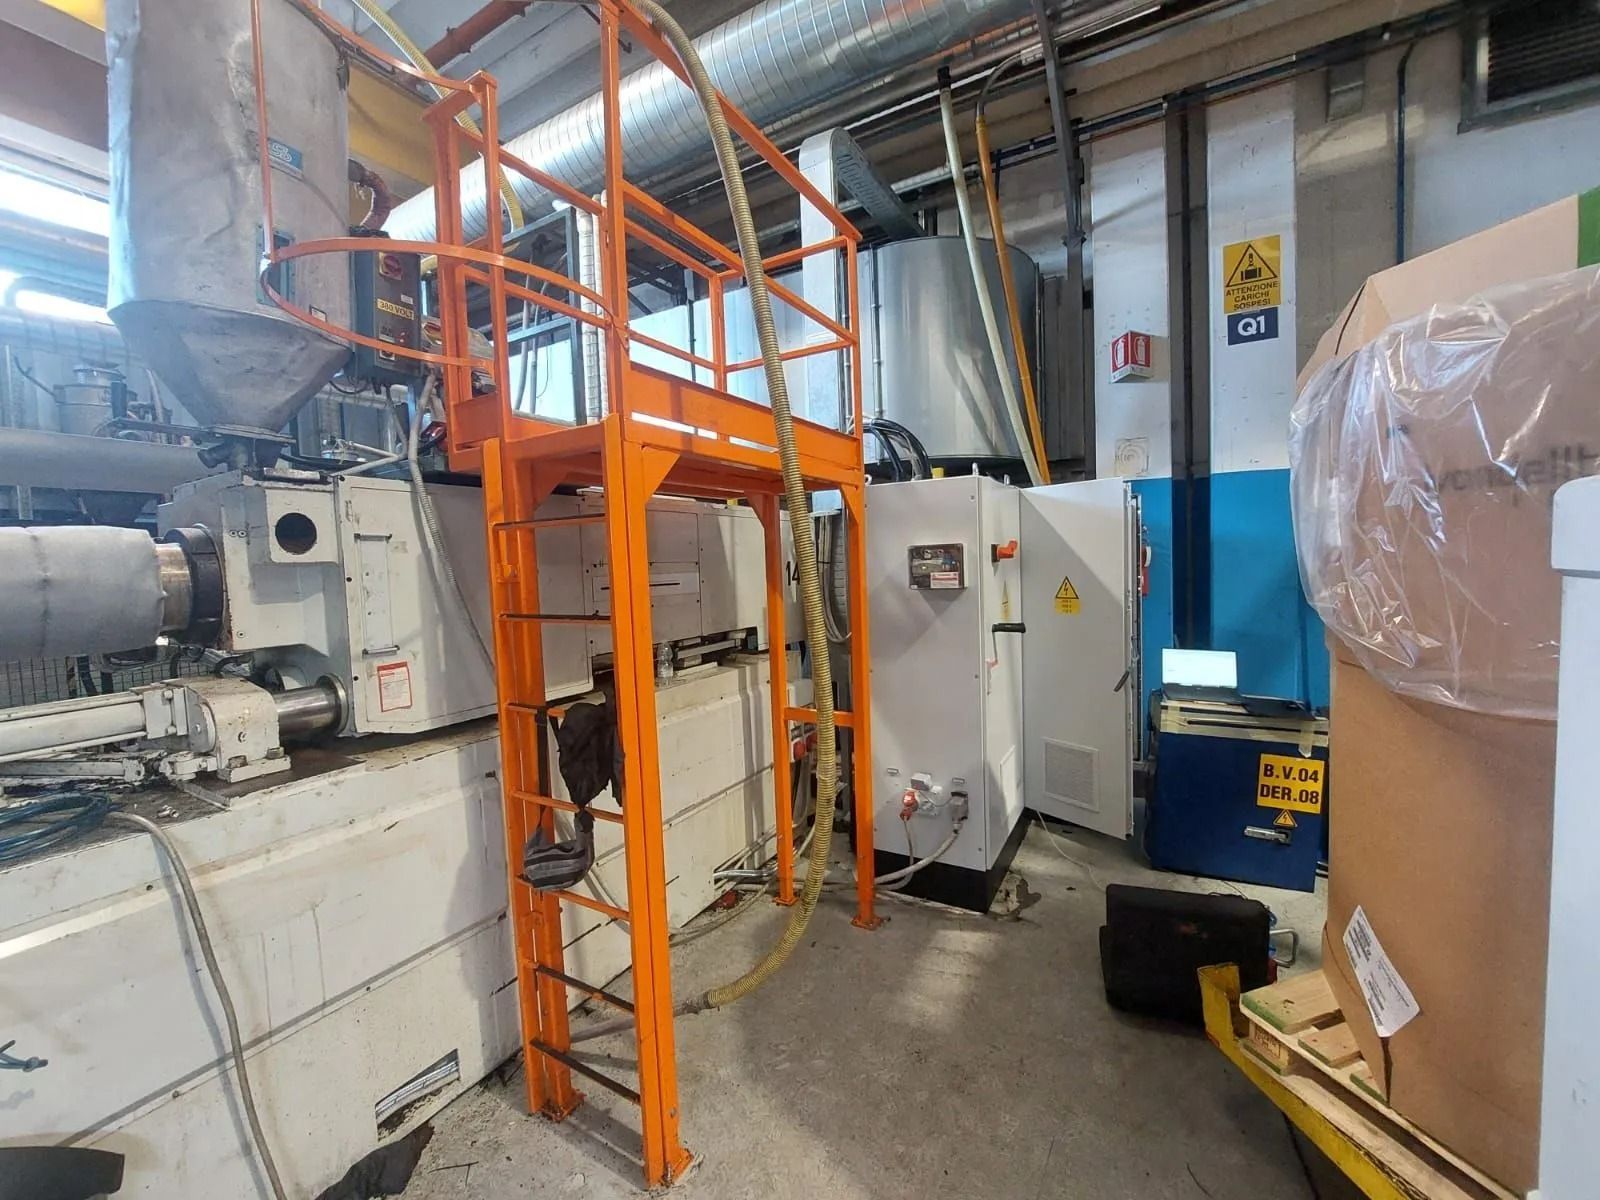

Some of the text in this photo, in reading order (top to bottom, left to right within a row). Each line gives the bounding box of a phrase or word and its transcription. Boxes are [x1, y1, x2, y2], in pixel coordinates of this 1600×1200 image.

[1226, 281, 1278, 297] ATTENZIONE
[1234, 291, 1270, 303] CARICHI
[395, 305, 413, 319] VOLT
[1233, 298, 1271, 311] SOSPESI
[1237, 315, 1266, 336] Q1
[1263, 763, 1319, 783] B.V.04
[1260, 783, 1320, 804] DER.08
